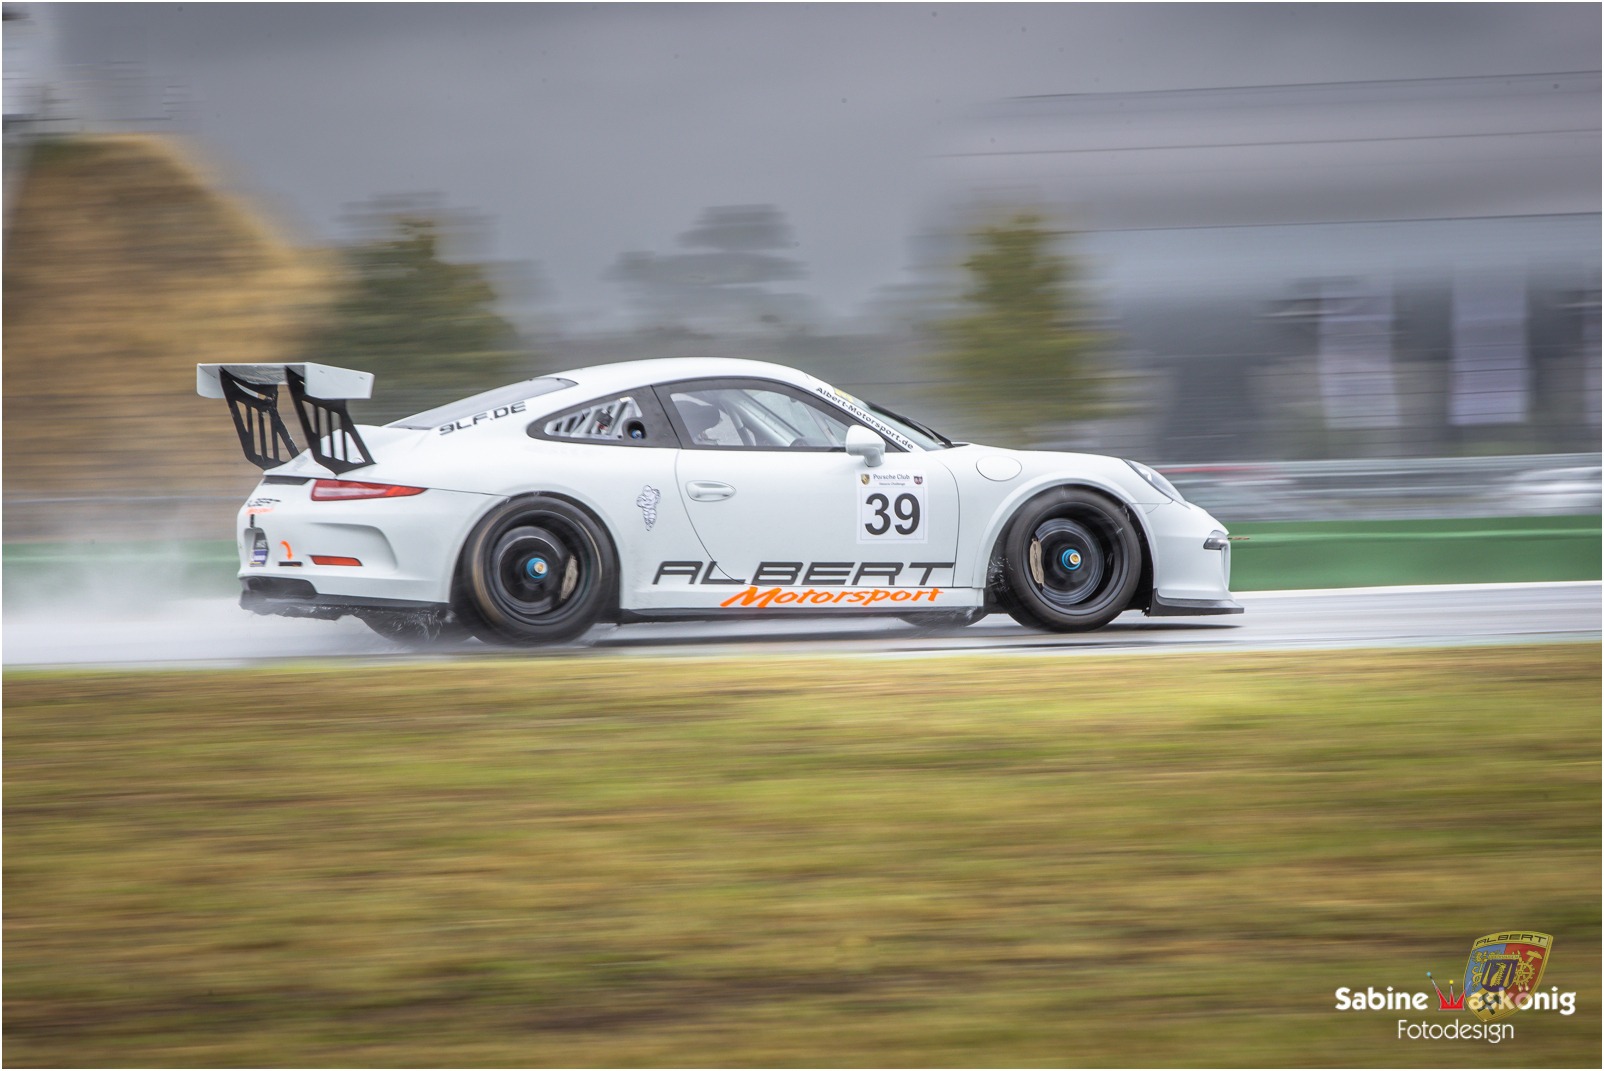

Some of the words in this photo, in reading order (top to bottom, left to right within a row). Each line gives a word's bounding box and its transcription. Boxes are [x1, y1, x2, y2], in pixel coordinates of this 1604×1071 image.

[439, 401, 527, 436] 9LF.DE
[815, 386, 914, 450] Albert-Motorsport.de
[864, 492, 921, 536] 39
[652, 560, 955, 586] ALBERT
[720, 586, 944, 609] Motorsport
